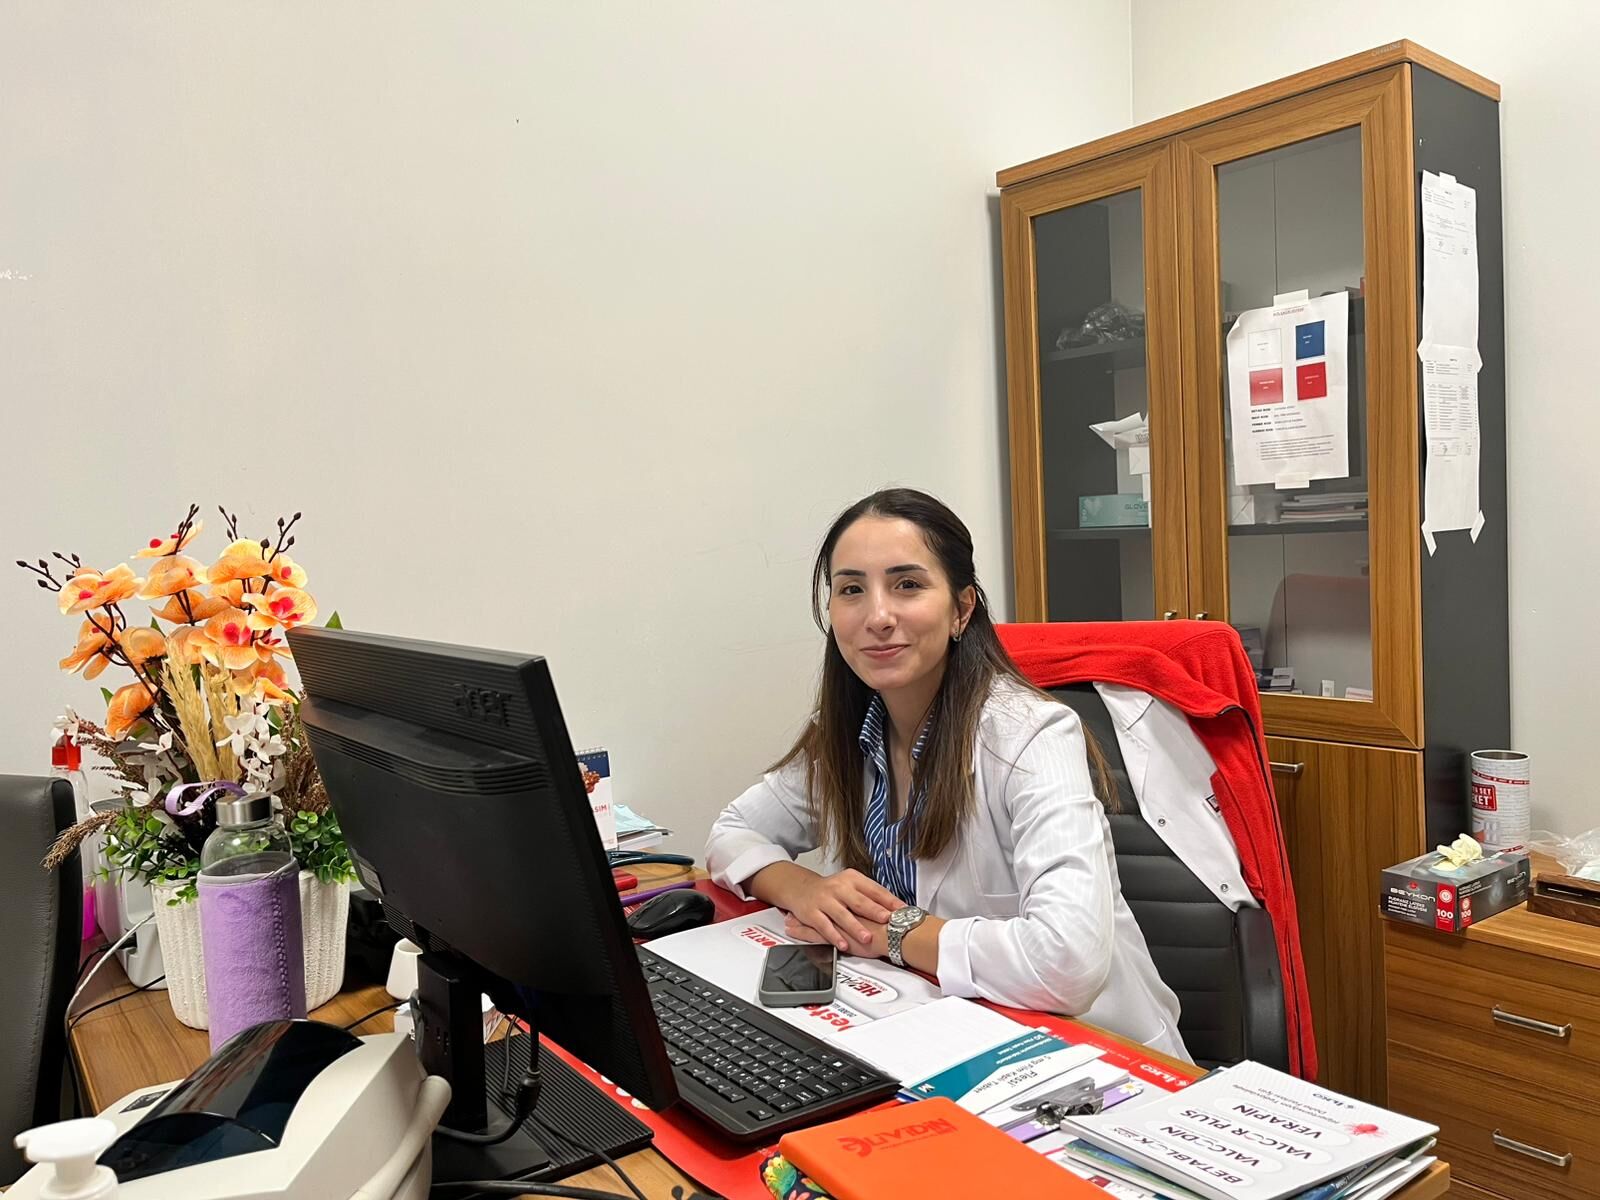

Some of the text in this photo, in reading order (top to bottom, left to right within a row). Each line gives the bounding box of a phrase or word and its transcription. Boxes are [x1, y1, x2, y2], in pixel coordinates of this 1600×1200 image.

[593, 804, 608, 813] SIM
[1390, 887, 1436, 902] BEYKON
[1437, 908, 1454, 919] 100
[1461, 909, 1472, 918] 100
[1180, 1109, 1232, 1130] PLUS
